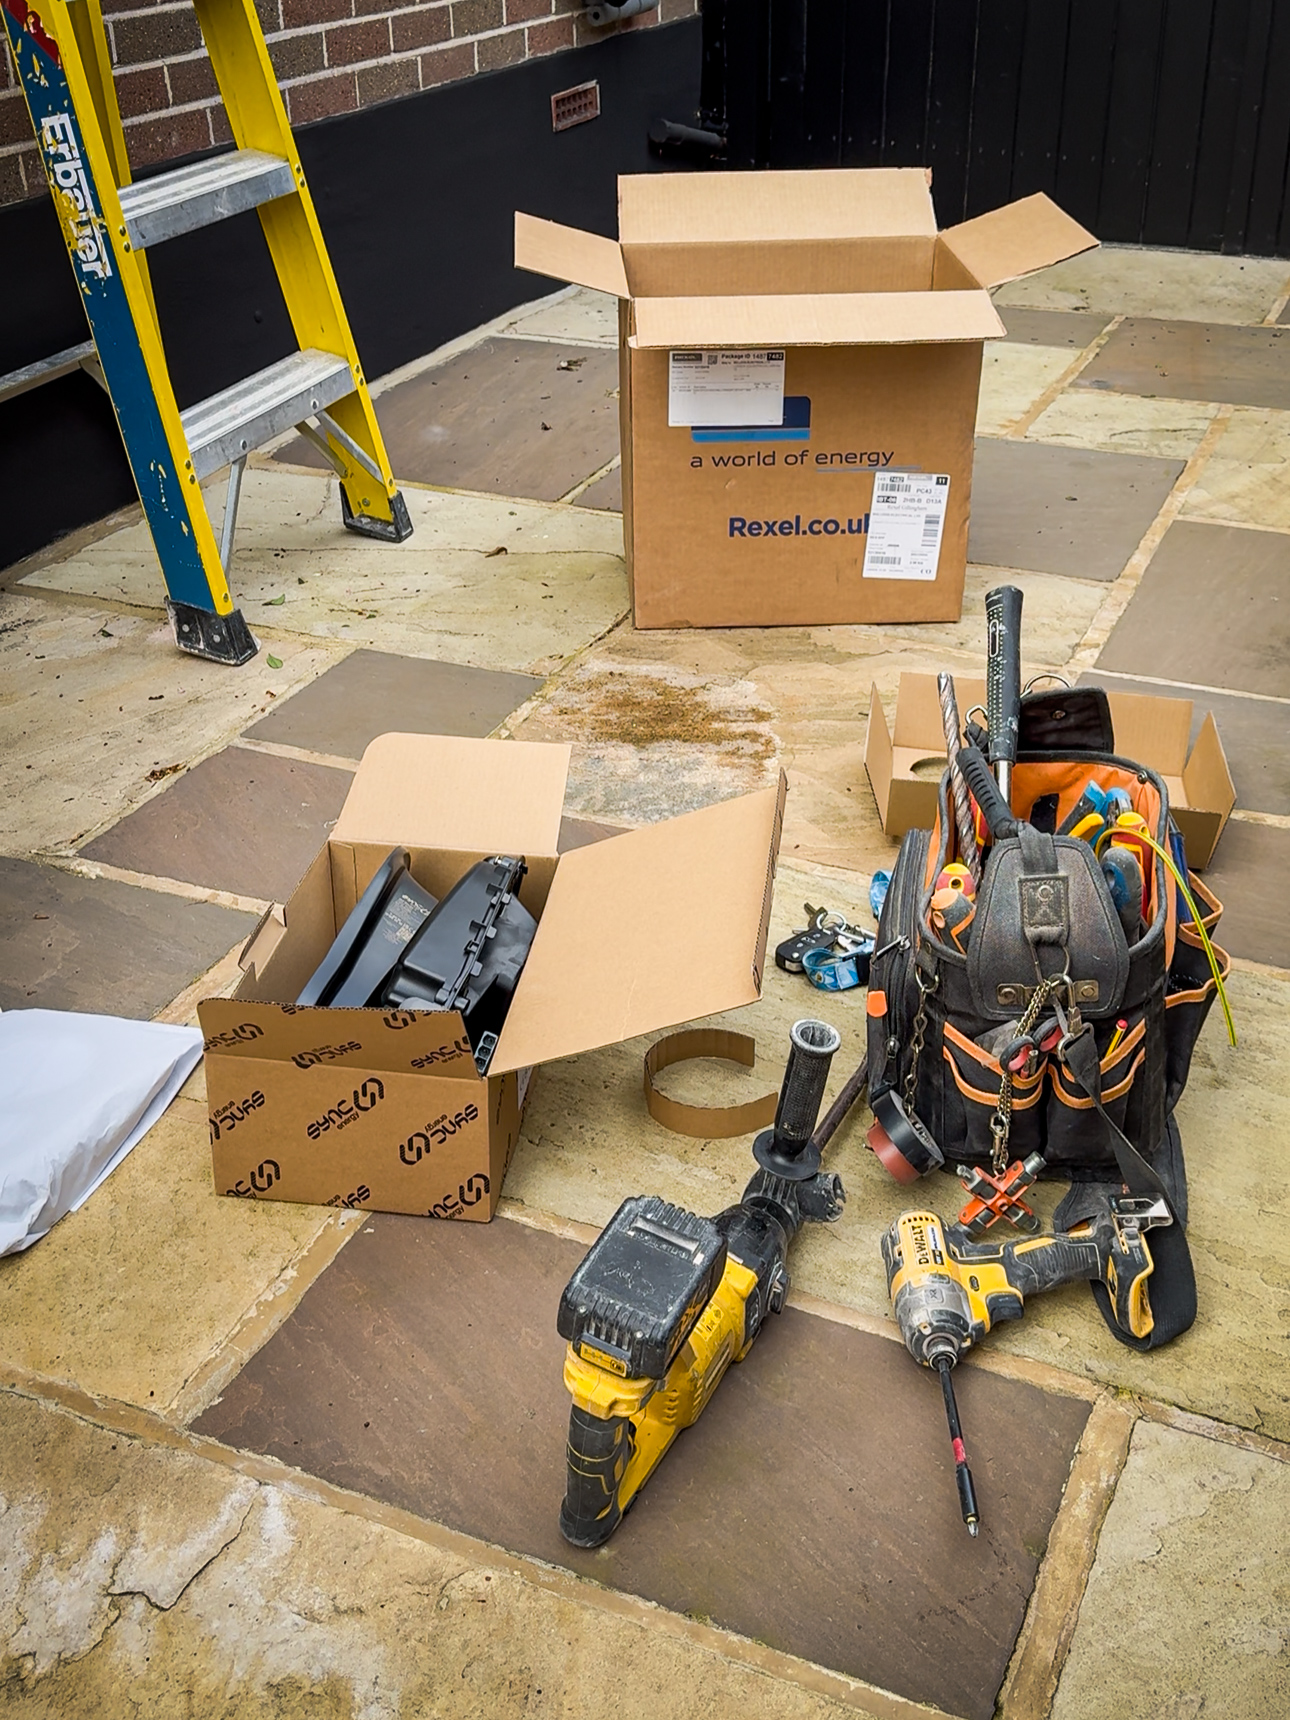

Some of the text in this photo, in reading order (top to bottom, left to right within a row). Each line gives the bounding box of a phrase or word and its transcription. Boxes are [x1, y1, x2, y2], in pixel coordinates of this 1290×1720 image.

[41, 113, 113, 279] Erbauer
[767, 352, 783, 360] 7482
[690, 450, 895, 468] a world of energy
[729, 513, 870, 537] Rexel.co.u
[307, 1099, 354, 1140] SYNC
[912, 1224, 930, 1265] DEWALT
